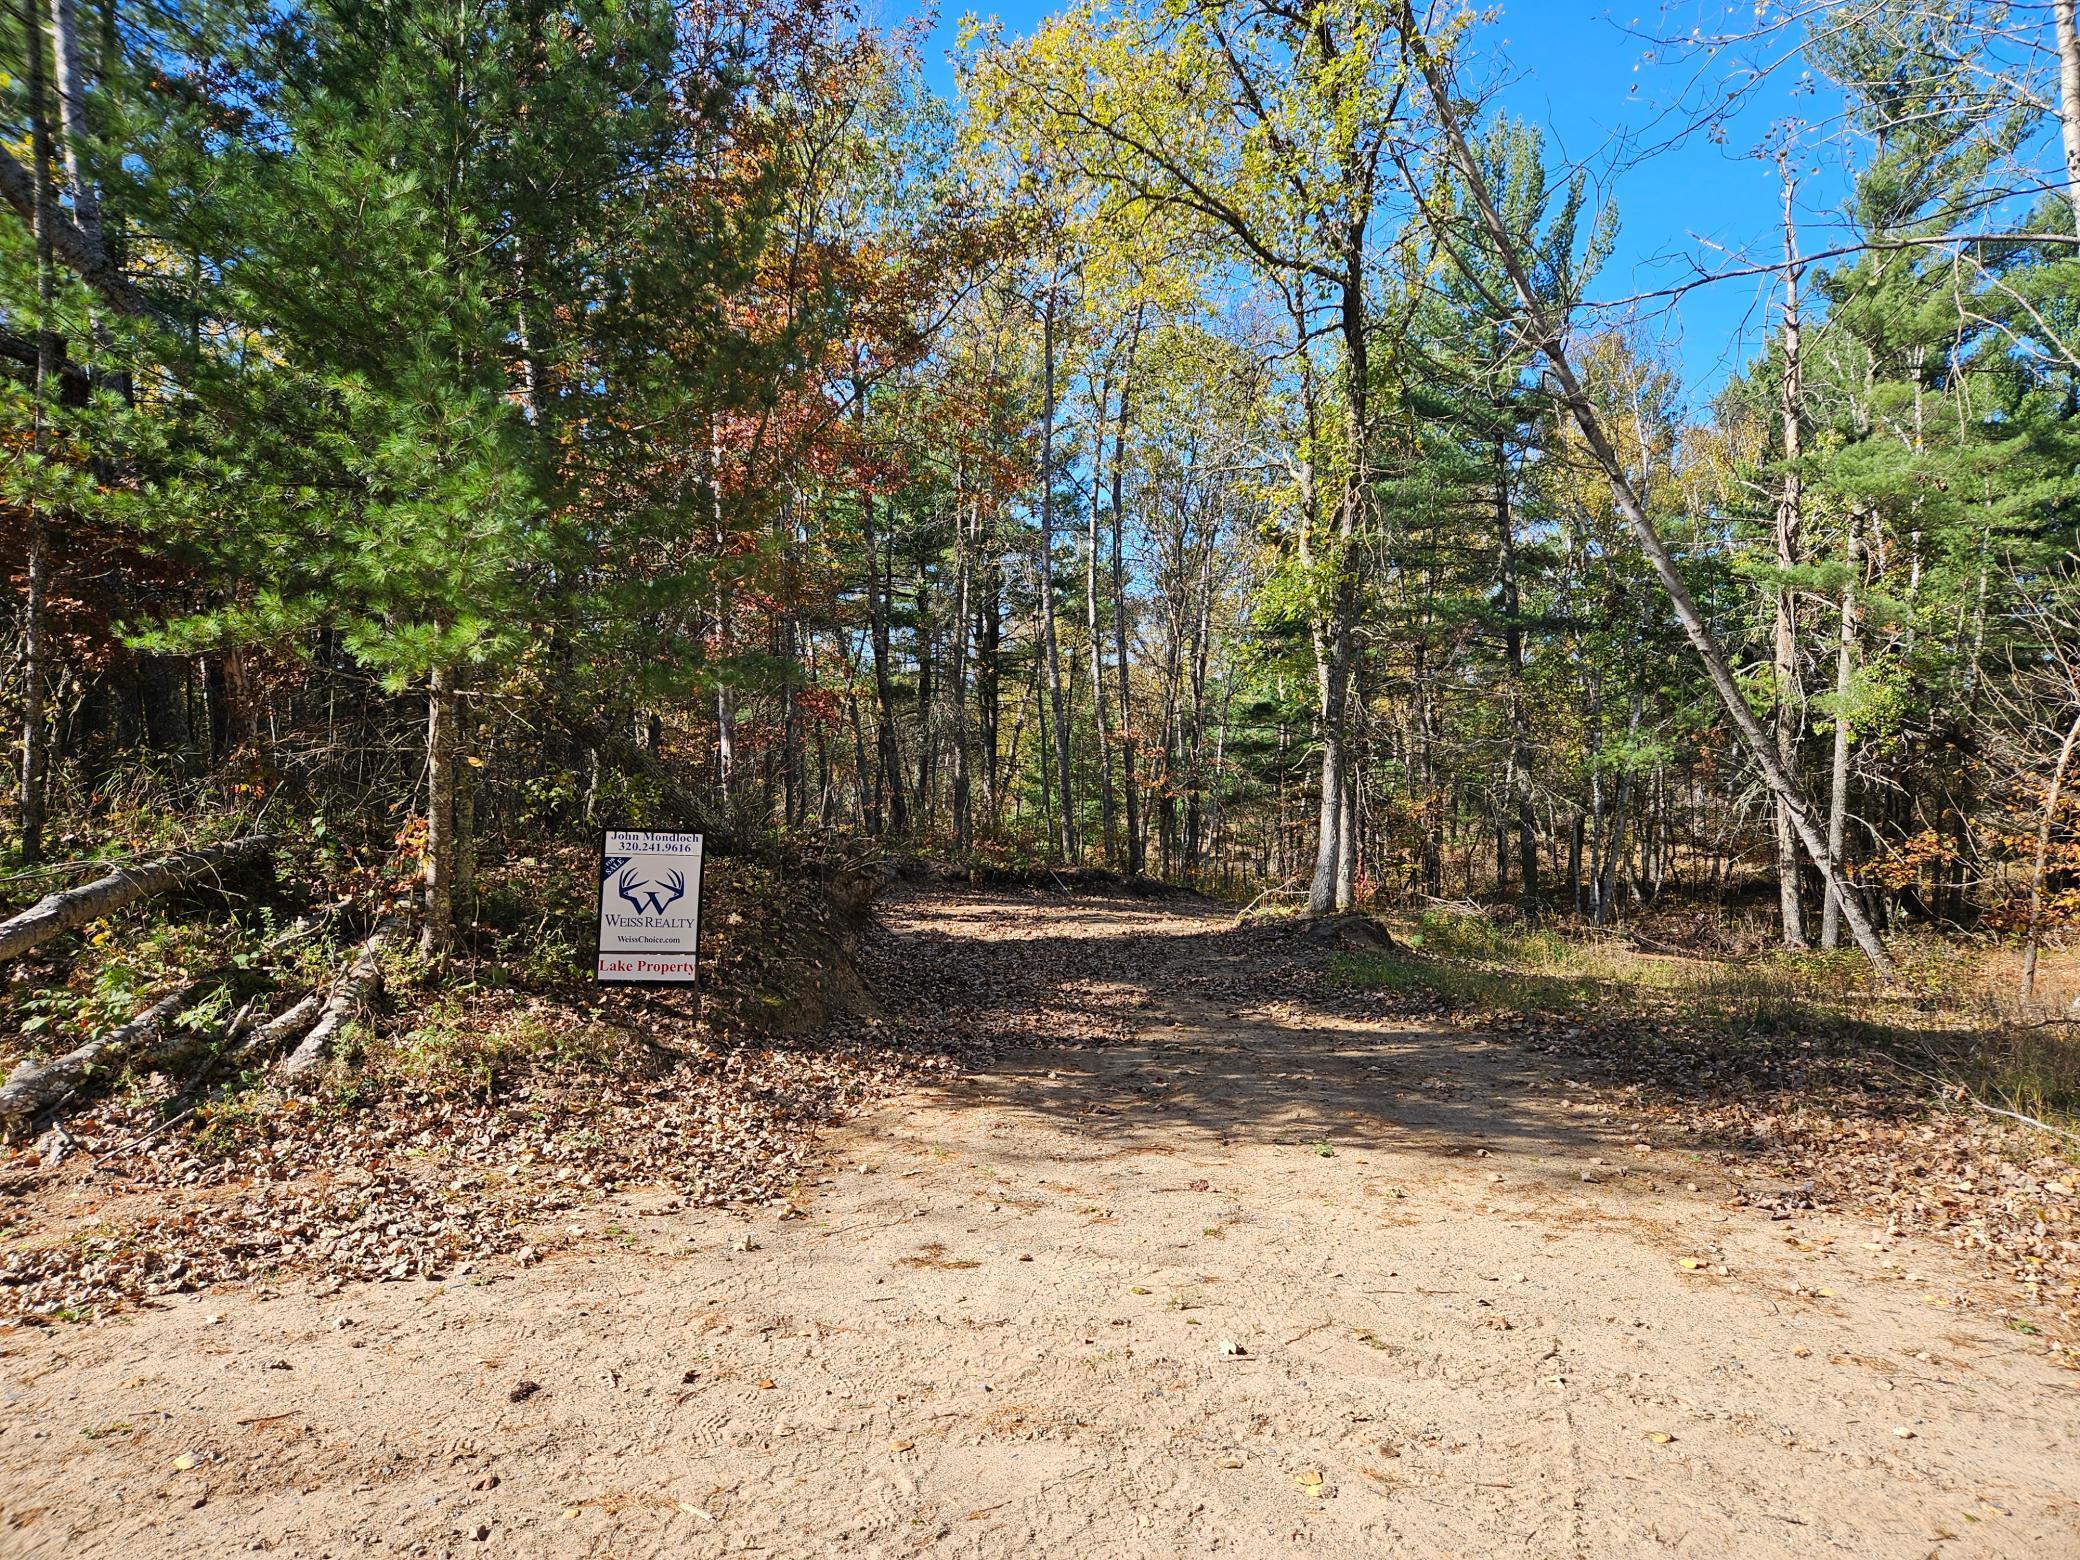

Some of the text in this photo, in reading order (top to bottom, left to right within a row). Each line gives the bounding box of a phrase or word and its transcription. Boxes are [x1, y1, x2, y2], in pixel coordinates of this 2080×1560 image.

[611, 831, 699, 843] John Mondloch
[618, 842, 691, 853] 320.241.9616
[605, 858, 625, 875] SALE
[605, 914, 695, 929] WEISS REALTY
[617, 935, 681, 944] WeissChoice.com
[599, 959, 696, 976] Lake Property
